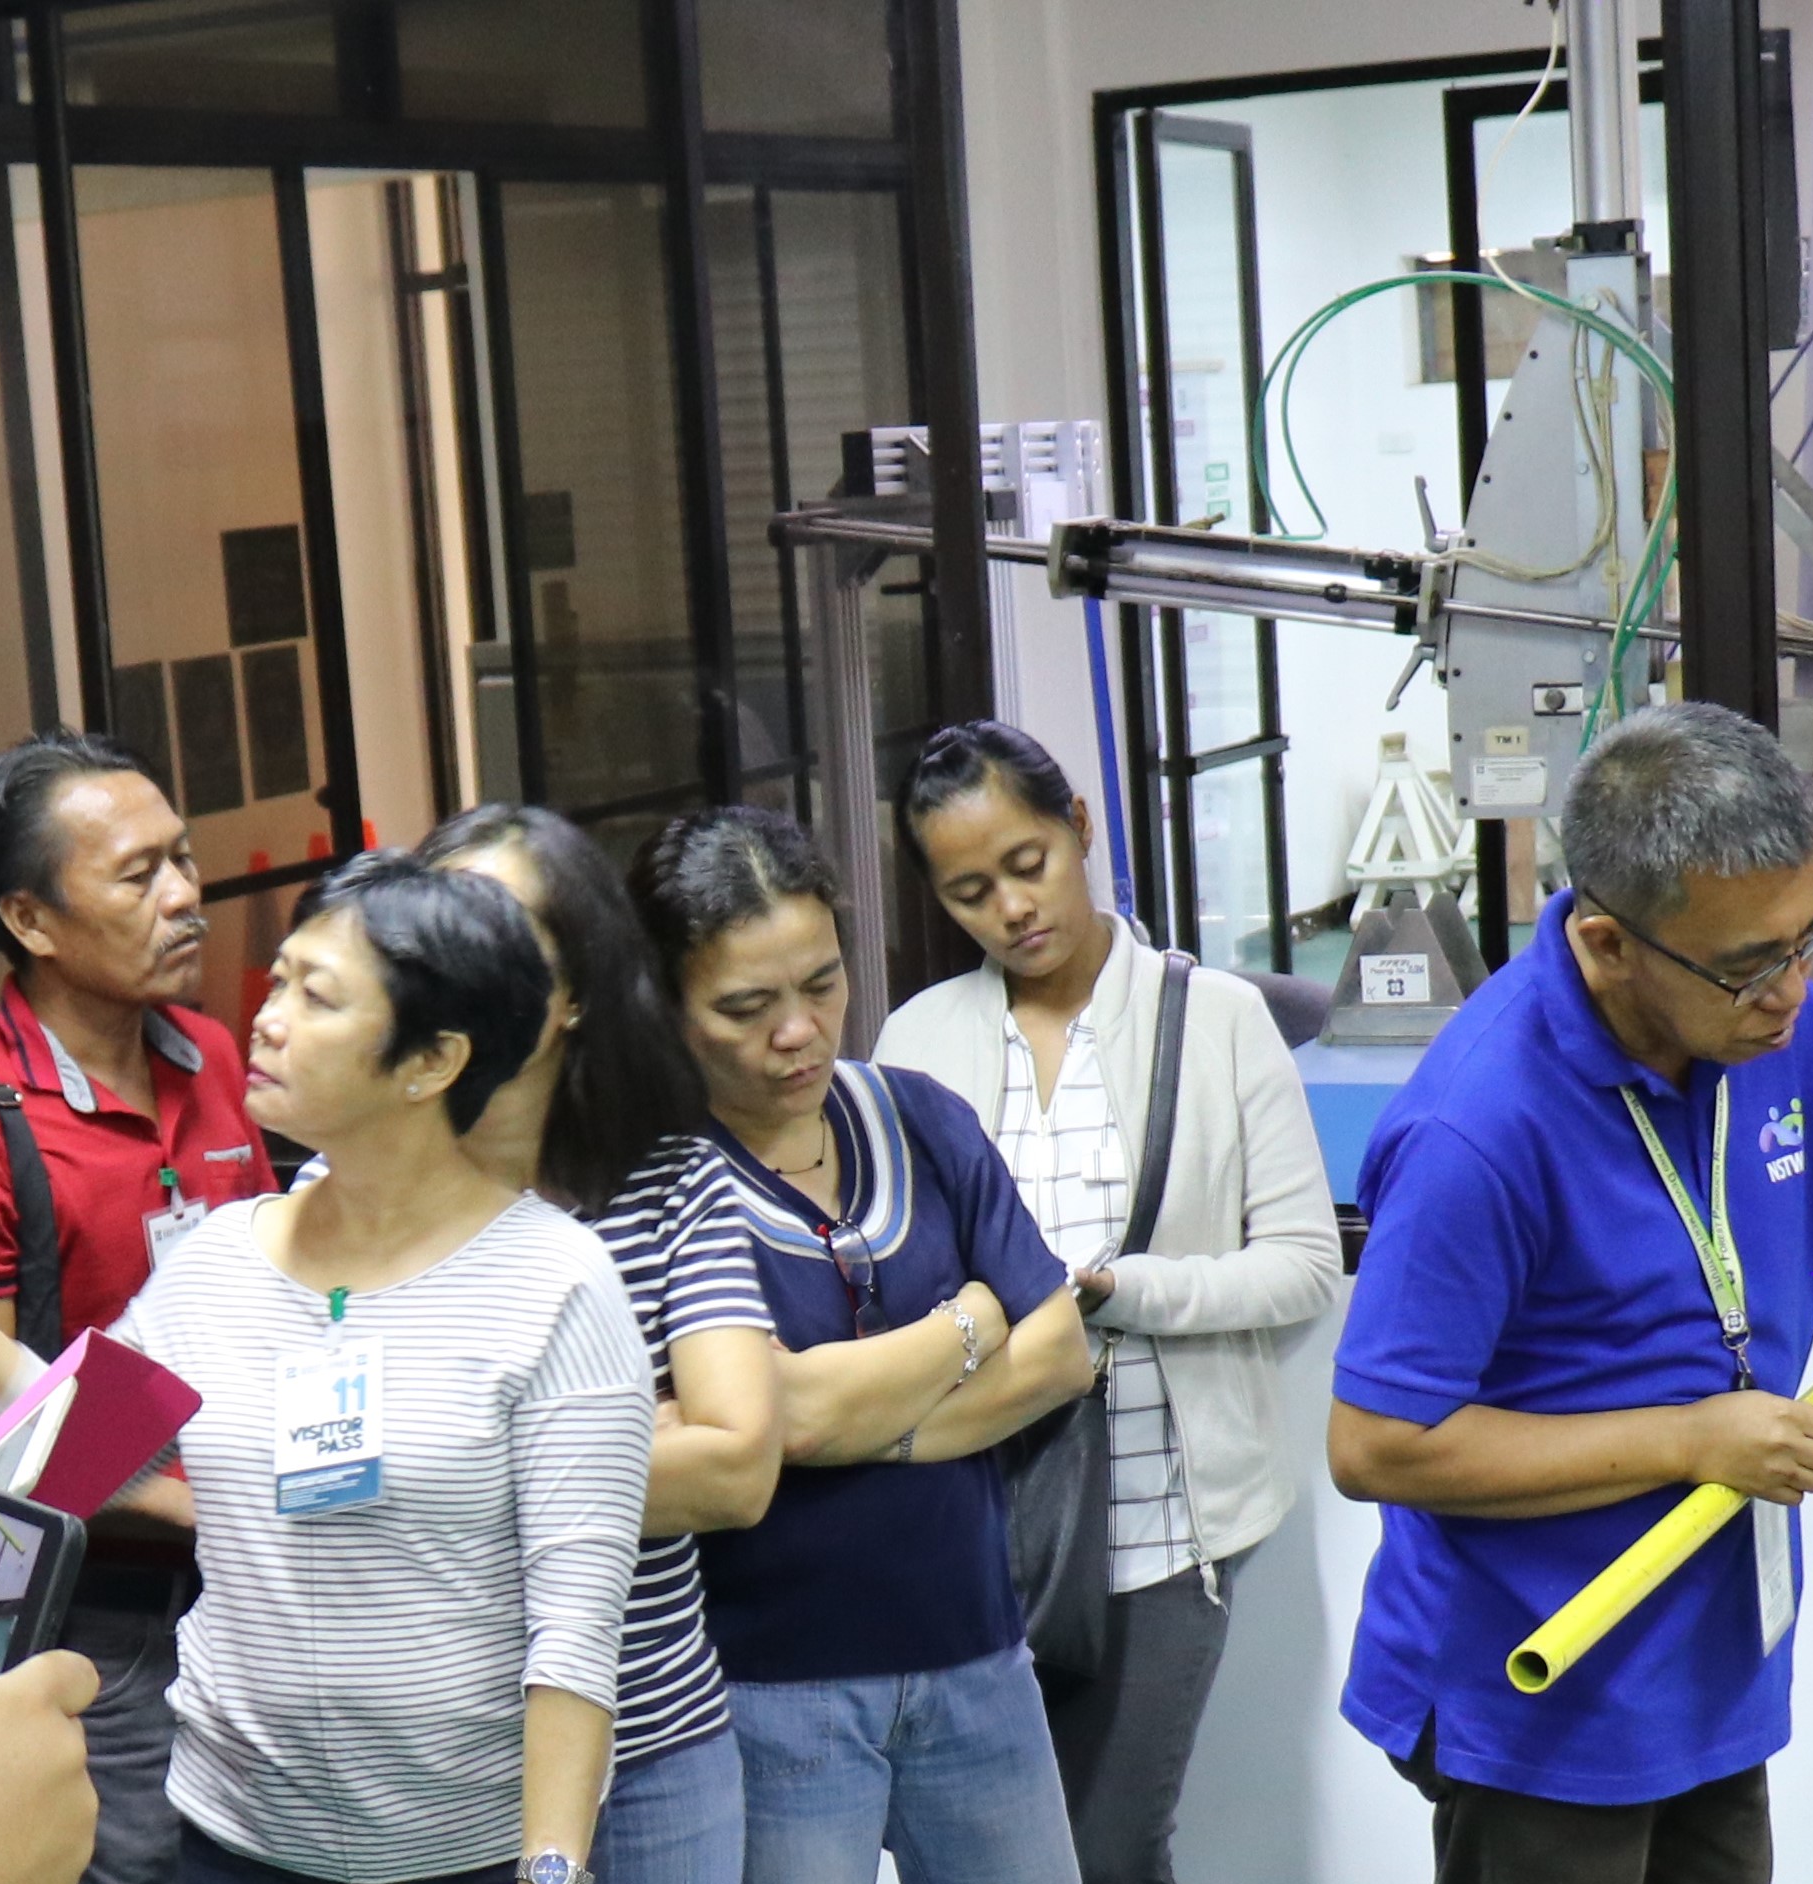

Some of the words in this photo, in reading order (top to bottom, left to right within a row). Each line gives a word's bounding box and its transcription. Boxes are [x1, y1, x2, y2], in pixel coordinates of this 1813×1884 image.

[332, 1373, 367, 1415] 11
[288, 1416, 364, 1443] VISITOR
[316, 1433, 364, 1456] PASS
